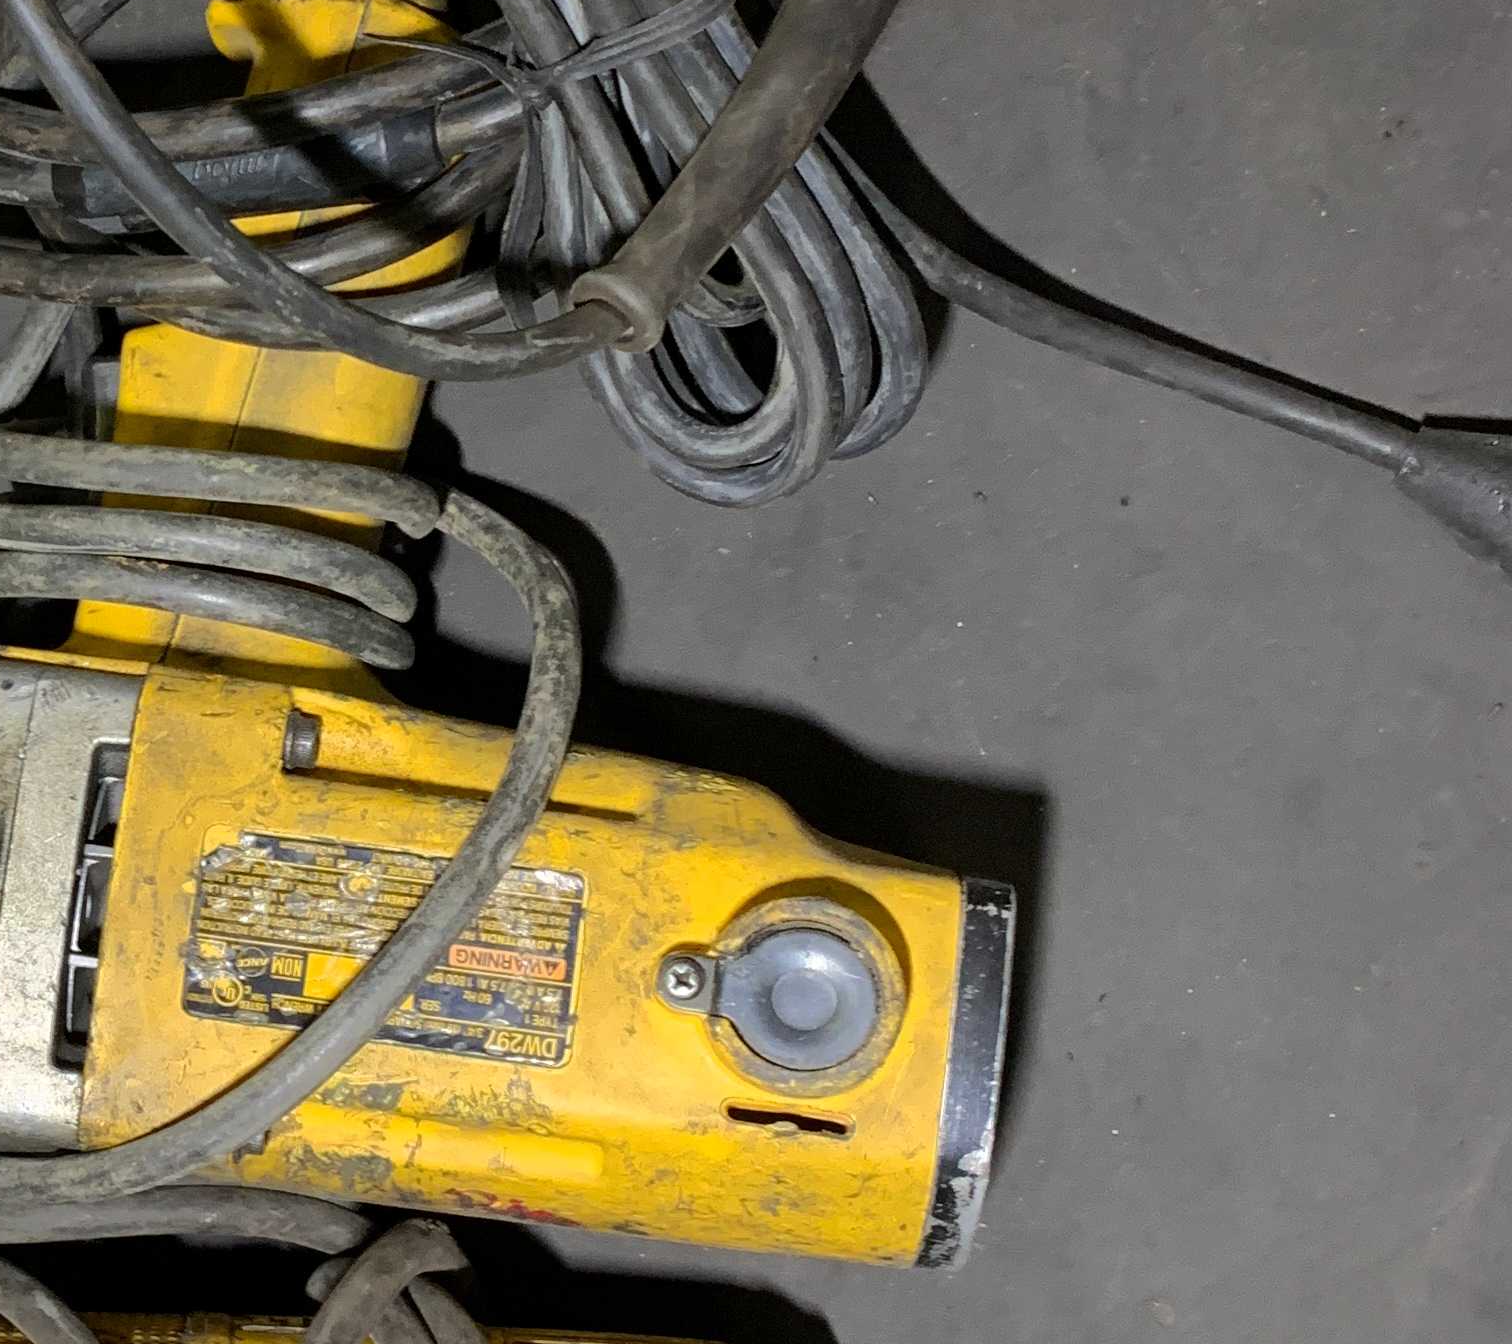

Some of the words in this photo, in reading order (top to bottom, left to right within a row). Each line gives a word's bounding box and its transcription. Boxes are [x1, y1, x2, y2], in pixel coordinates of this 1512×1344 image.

[270, 955, 303, 977] NOM
[454, 947, 543, 974] WARNING
[530, 1013, 558, 1027] TYPE
[482, 1027, 558, 1059] DW297
